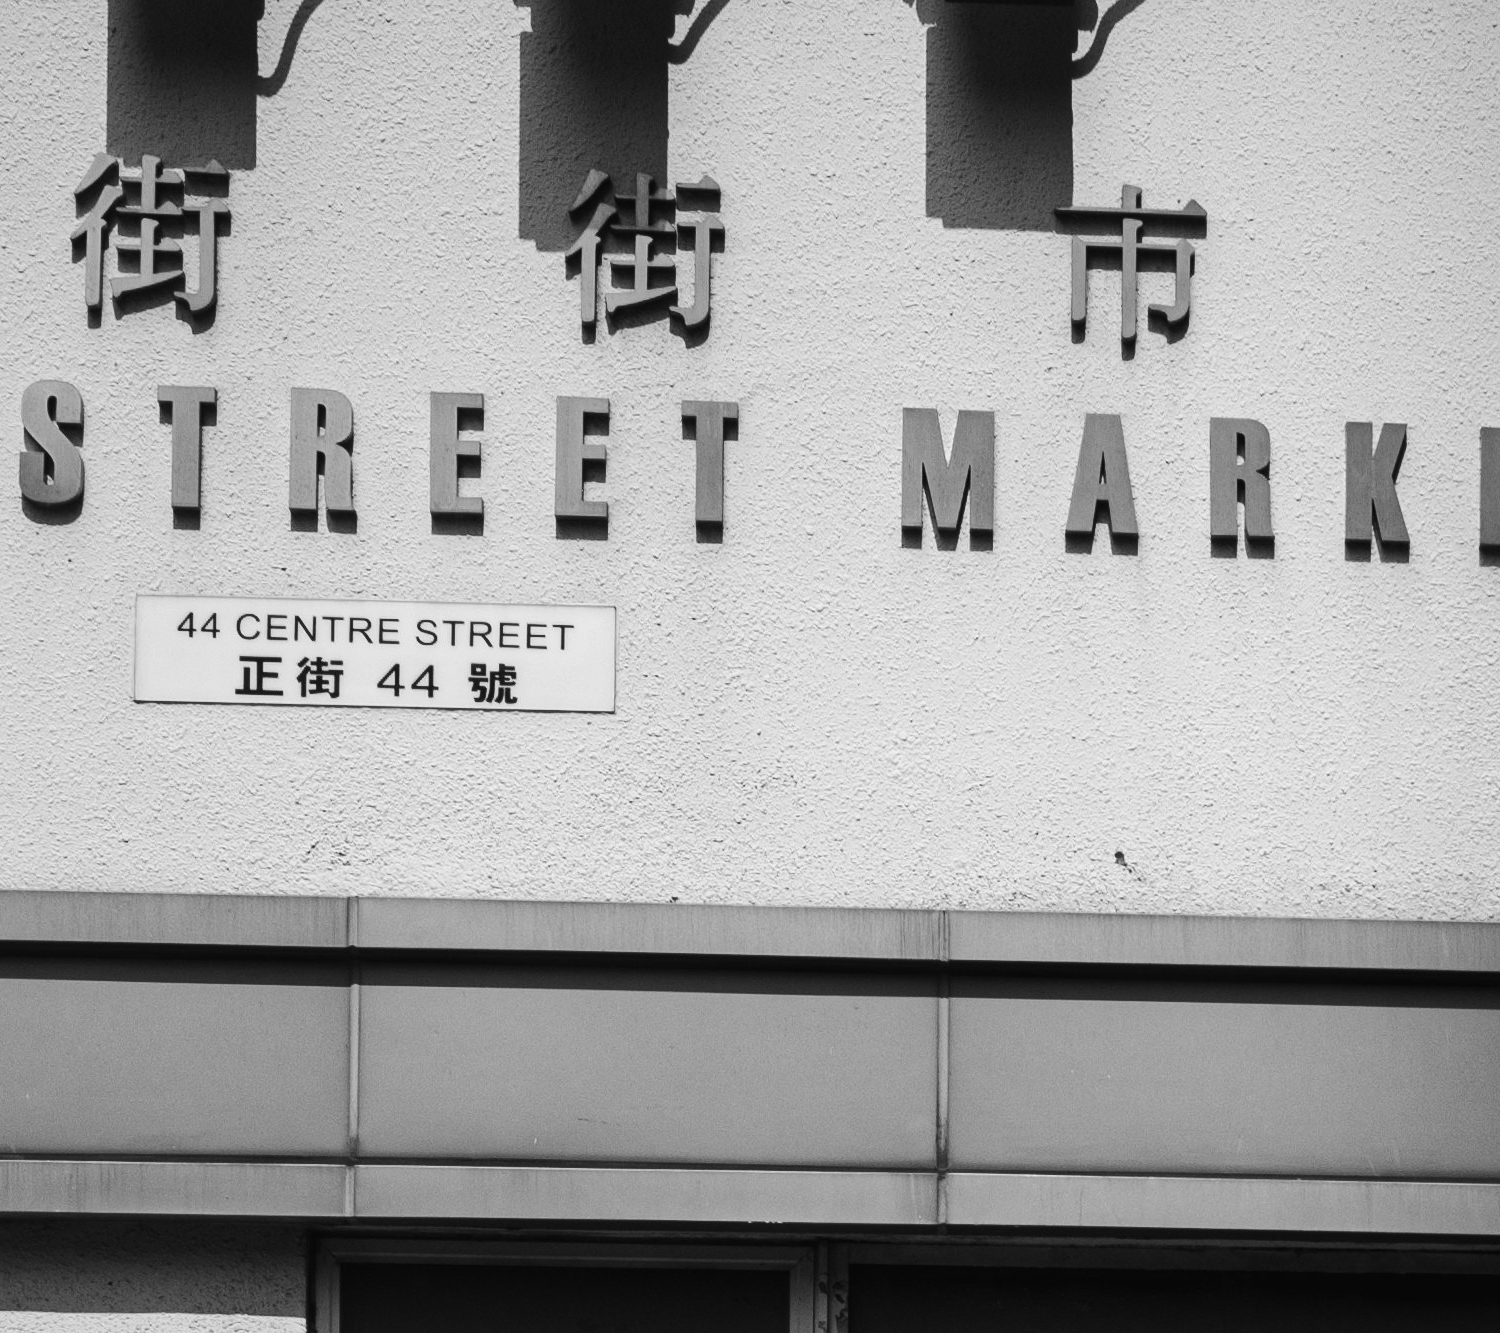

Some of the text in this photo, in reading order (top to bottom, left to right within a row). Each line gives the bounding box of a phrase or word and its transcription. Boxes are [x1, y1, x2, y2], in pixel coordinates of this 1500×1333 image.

[18, 378, 740, 530] STREET
[177, 611, 575, 651] 44 CENTRE STREET
[234, 655, 518, 704] 正街 44 號
